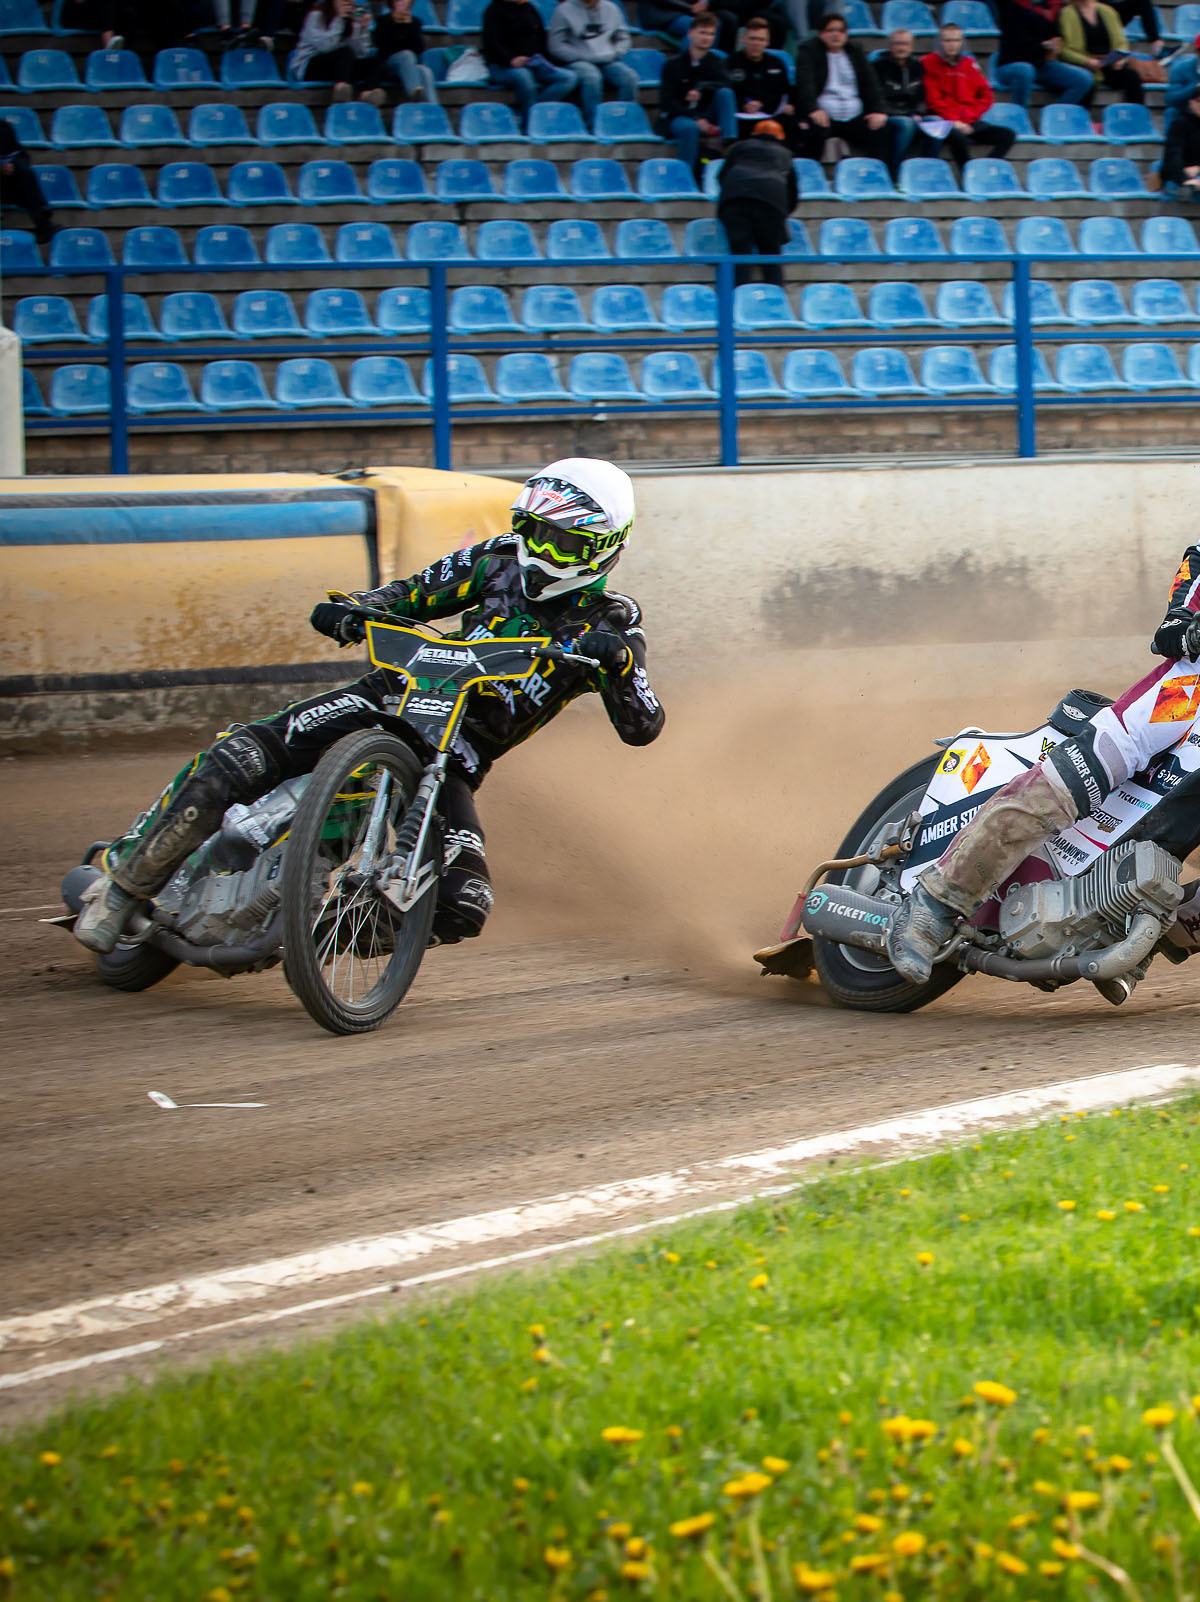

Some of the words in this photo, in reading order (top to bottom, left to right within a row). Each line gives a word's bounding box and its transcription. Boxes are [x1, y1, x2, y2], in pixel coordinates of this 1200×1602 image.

[1065, 743, 1090, 780] AMBER
[919, 814, 958, 847] AMBER
[960, 804, 982, 827] STU
[1053, 847, 1079, 867] FAMILY
[826, 901, 889, 927] TICKETKOS
